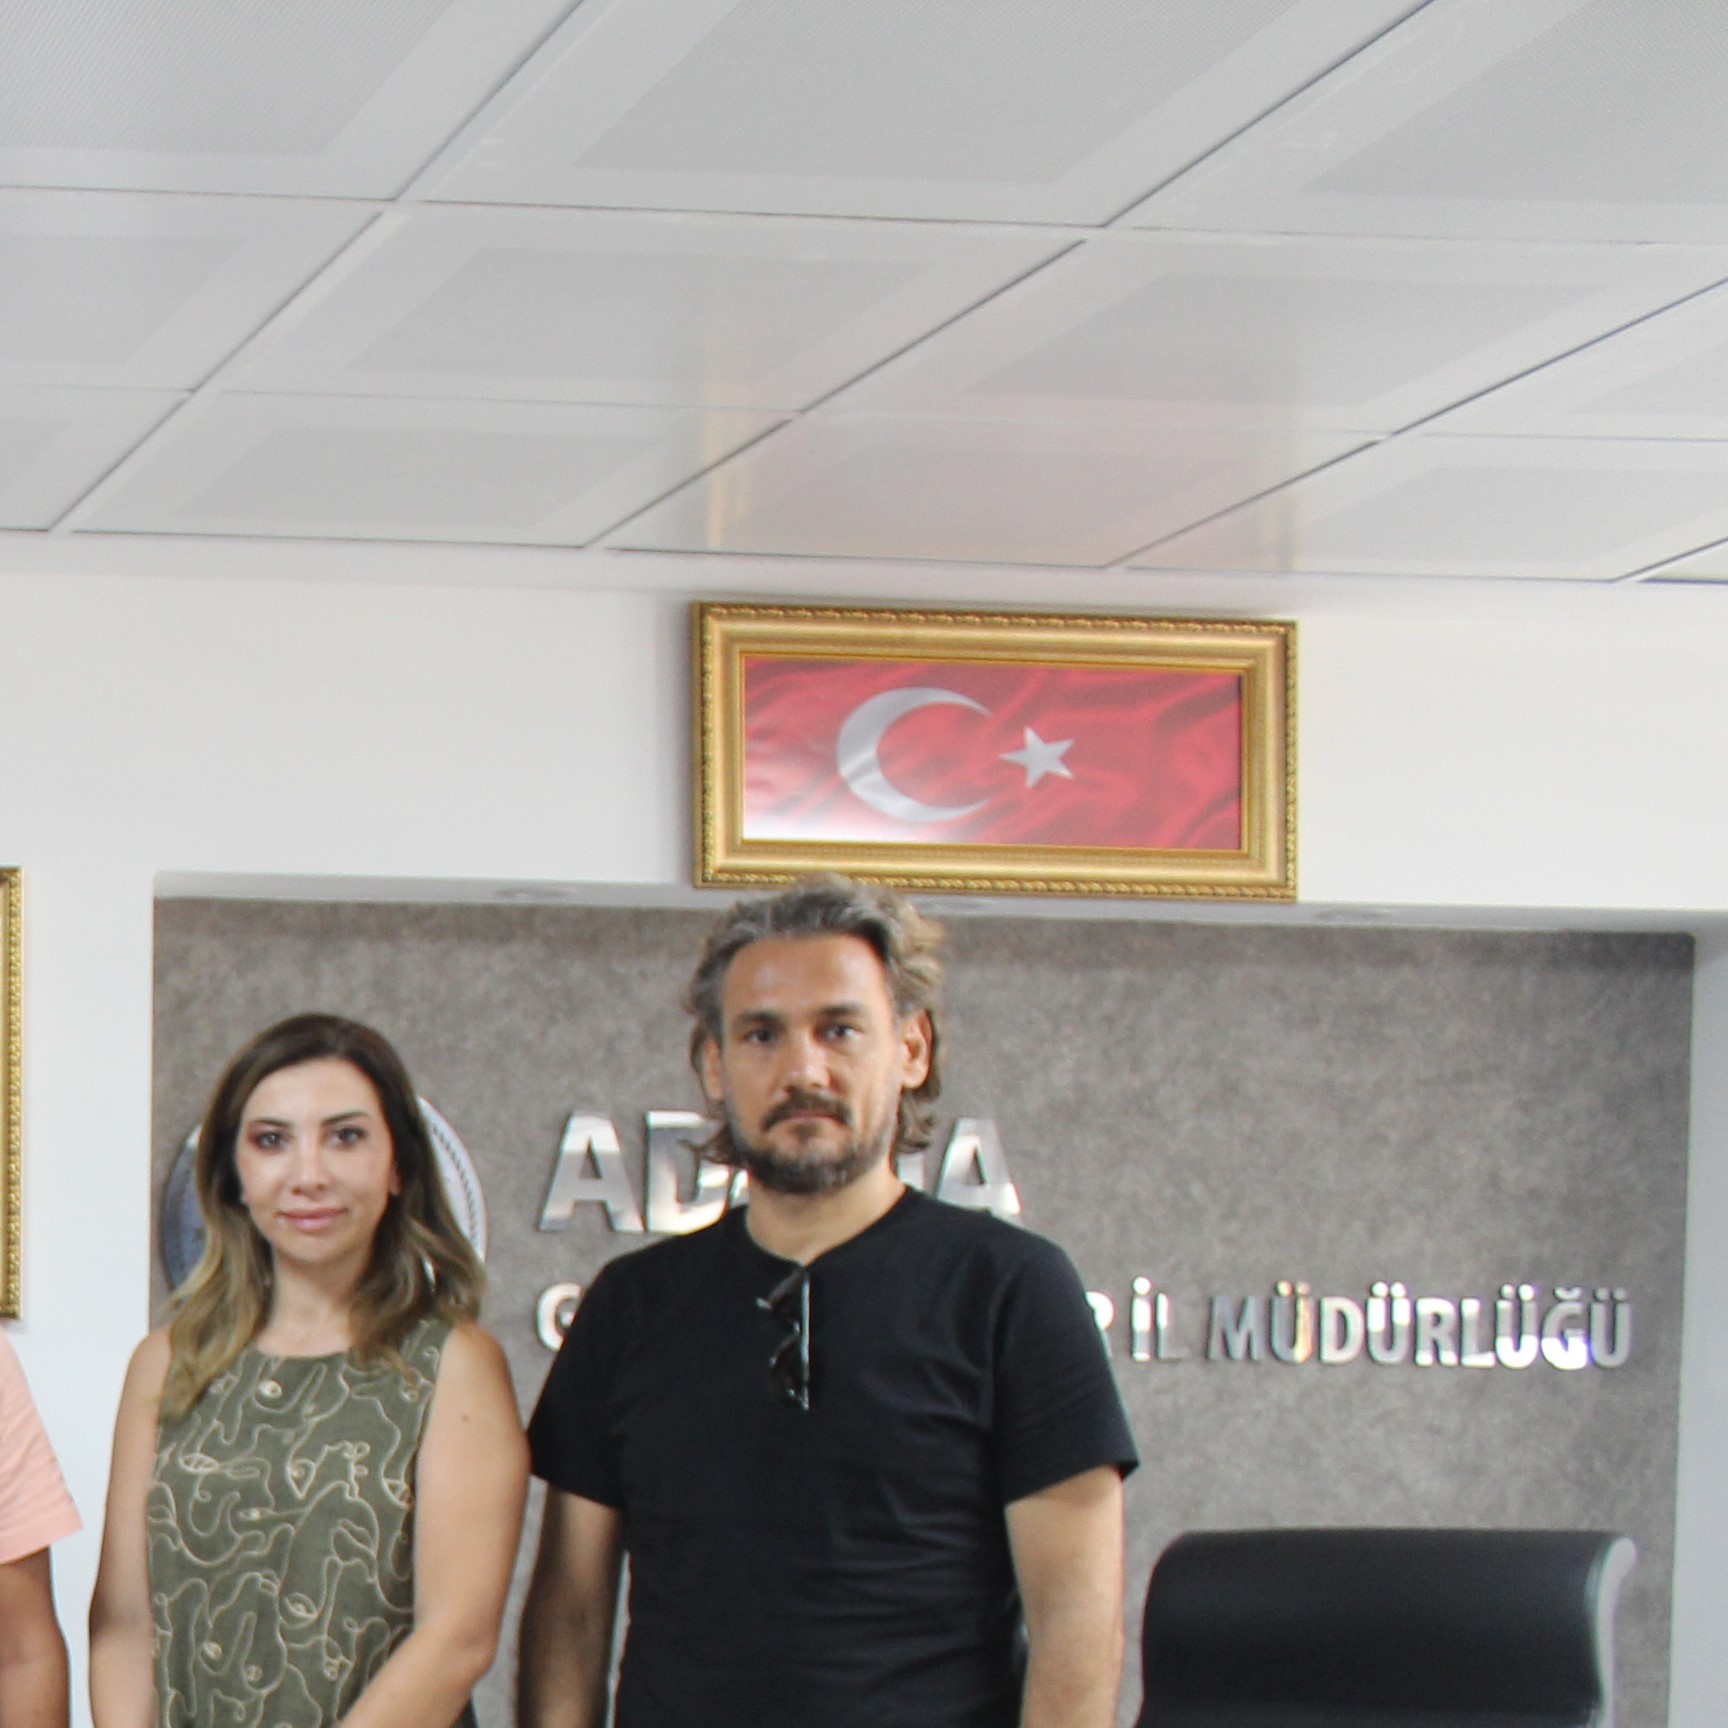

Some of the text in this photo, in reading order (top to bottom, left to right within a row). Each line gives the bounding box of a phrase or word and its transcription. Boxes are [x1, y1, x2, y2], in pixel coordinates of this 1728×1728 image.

[539, 1110, 1022, 1233] ADA
[1132, 1276, 1187, 1362] İL
[1207, 1280, 1631, 1370] MÜDÜRLÜĞÜ
